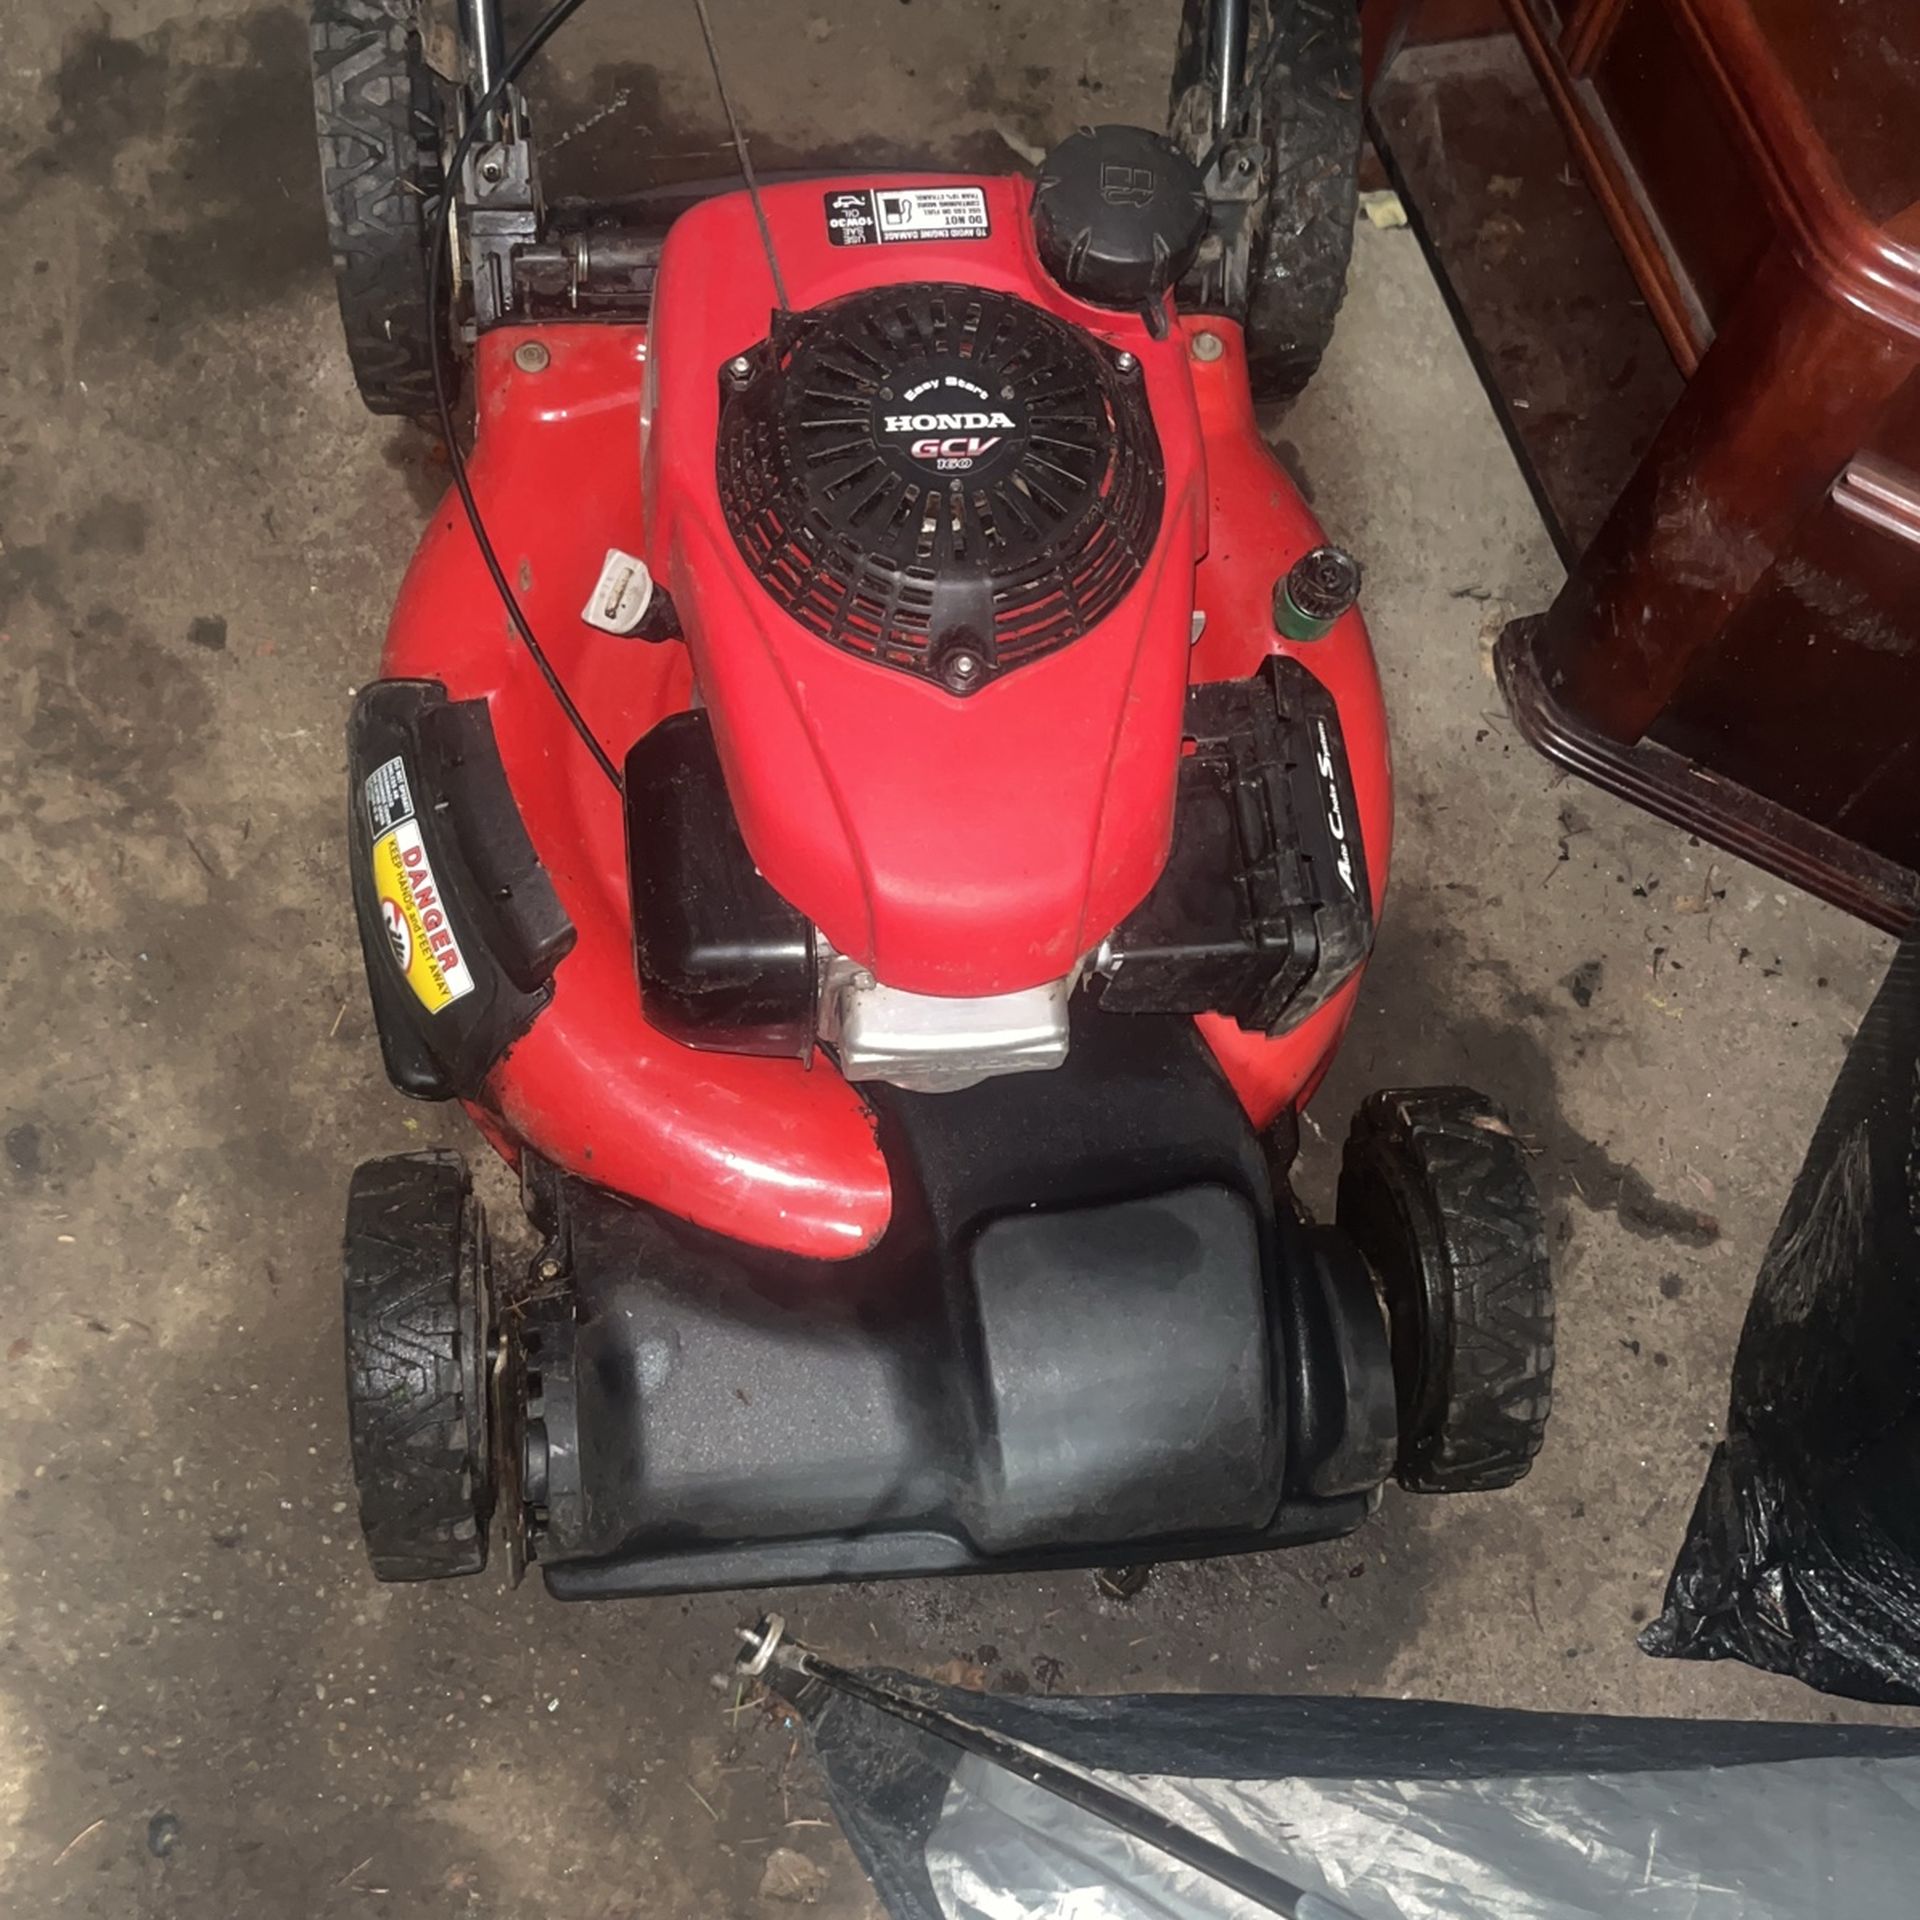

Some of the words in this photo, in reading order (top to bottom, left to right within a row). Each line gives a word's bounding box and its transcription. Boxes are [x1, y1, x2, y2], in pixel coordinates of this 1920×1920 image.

[841, 208, 860, 217] OIL
[829, 216, 874, 228] 10W30
[945, 216, 966, 225] NOT
[968, 215, 982, 224] DO
[842, 226, 864, 236] SAE
[884, 231, 919, 240] DAMAGE
[920, 229, 950, 239] ENGINE
[950, 228, 974, 237] AVOID
[843, 235, 866, 245] USE
[903, 379, 940, 402] Easy
[944, 376, 989, 400] Start
[884, 412, 1016, 432] HONDA
[911, 437, 1002, 458] GCV
[937, 458, 973, 470] 160
[1317, 720, 1334, 780] System
[1328, 783, 1345, 840] Choke
[1336, 843, 1355, 893] Auto
[401, 845, 459, 973] DANGER
[388, 841, 403, 869] KEEP
[396, 870, 417, 911] HANDS
[409, 912, 422, 934] and
[416, 932, 435, 962] FEET
[428, 963, 450, 996] AWAY
